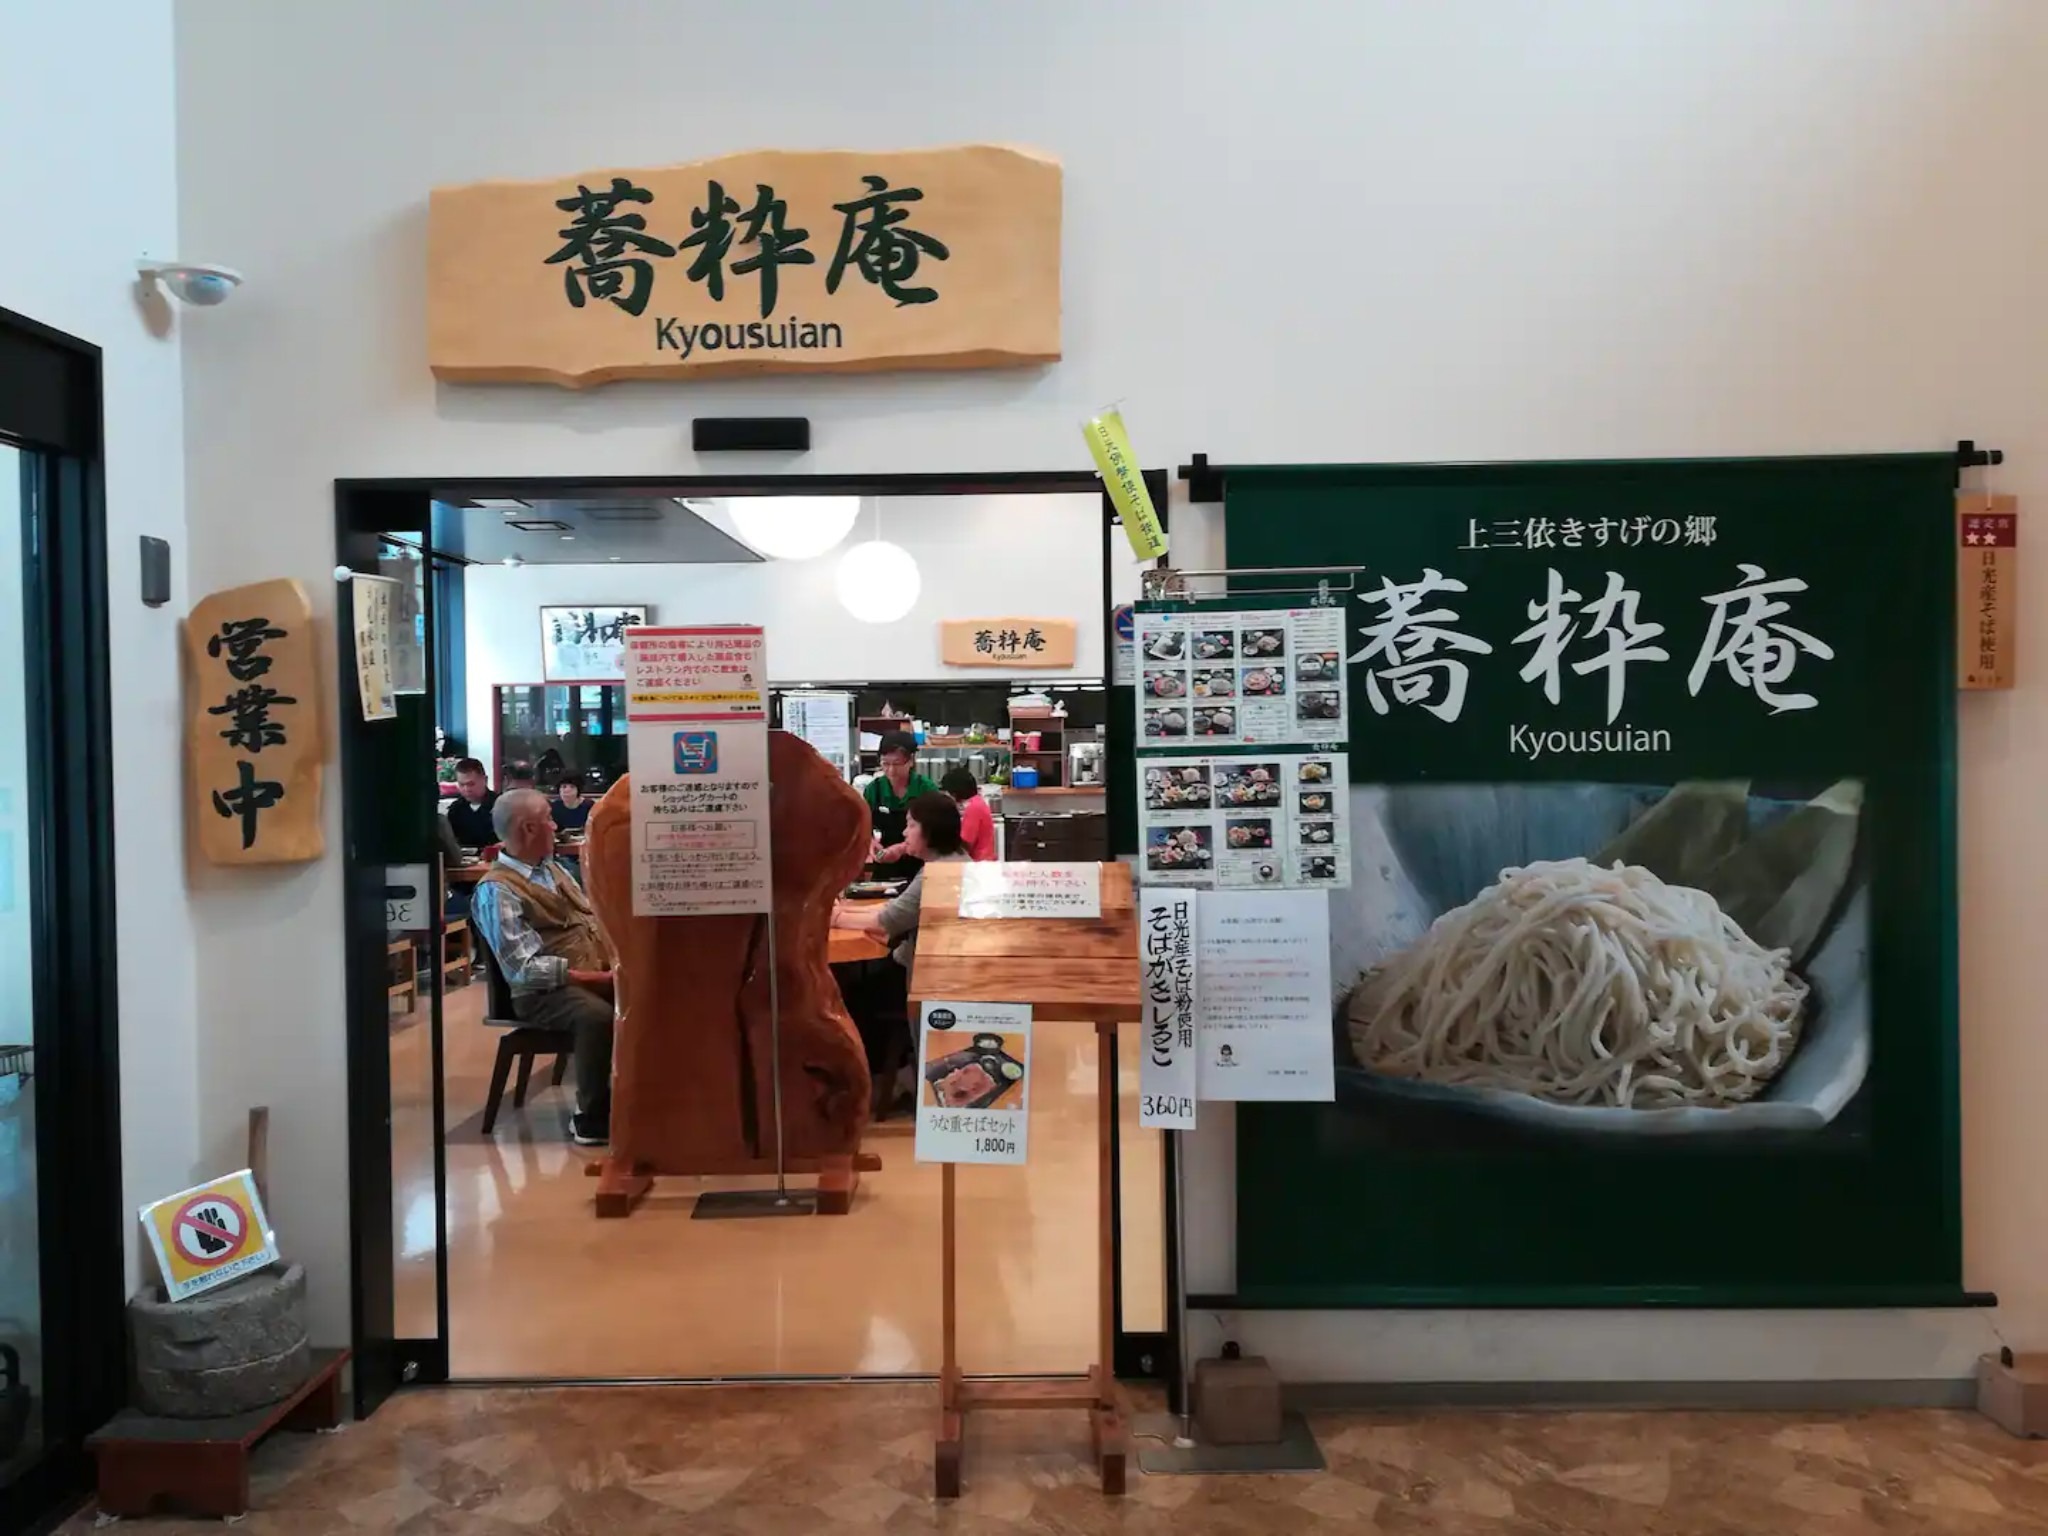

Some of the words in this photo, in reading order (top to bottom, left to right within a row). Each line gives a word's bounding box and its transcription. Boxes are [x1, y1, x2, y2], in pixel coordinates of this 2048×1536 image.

[543, 175, 950, 319] 蕎粋庵
[656, 317, 843, 360] Kyousuian
[1457, 516, 1718, 550] 上三依きすげの郷
[973, 628, 1047, 654] 蕎粋庵
[1345, 563, 1836, 726] 蕎粋庵
[206, 617, 298, 851] 営業中
[1509, 724, 1672, 760] Kyousuian
[1146, 907, 1174, 1068] そばがきしるこ
[1173, 901, 1194, 1049] 日光産そば粉使用
[929, 1114, 1016, 1135] うな重そばセット
[1142, 1095, 1193, 1118] 360円
[975, 1138, 1016, 1155] 1,800円
